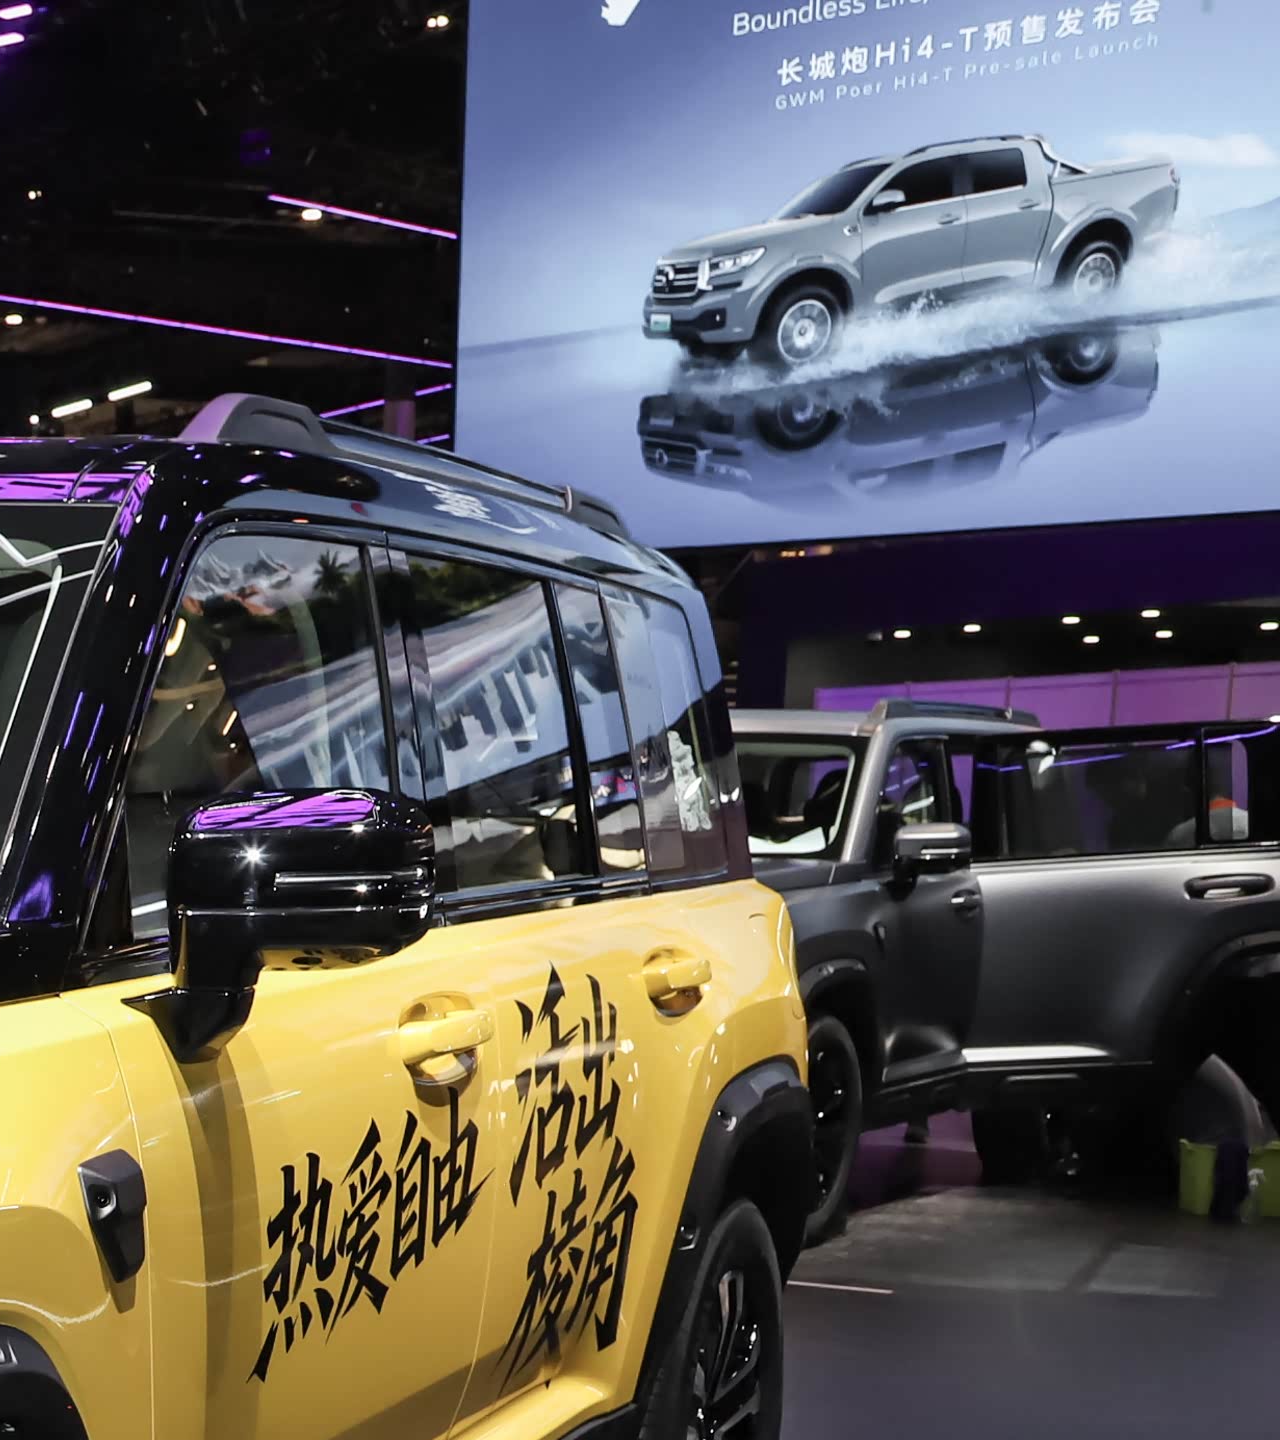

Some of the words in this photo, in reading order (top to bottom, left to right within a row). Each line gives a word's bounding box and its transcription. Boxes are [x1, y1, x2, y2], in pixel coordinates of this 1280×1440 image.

[732, 0, 866, 36] Boundless
[776, 0, 1160, 86] 长城炮Hi4-T预售发布会
[775, 89, 825, 110] GWM
[836, 81, 882, 100] Poer
[894, 66, 952, 91] Hi4-T
[964, 50, 1062, 79] Pre-sale
[1074, 31, 1158, 61] Launch
[509, 960, 621, 1208] 活出
[246, 1087, 496, 1384] 热爱自由
